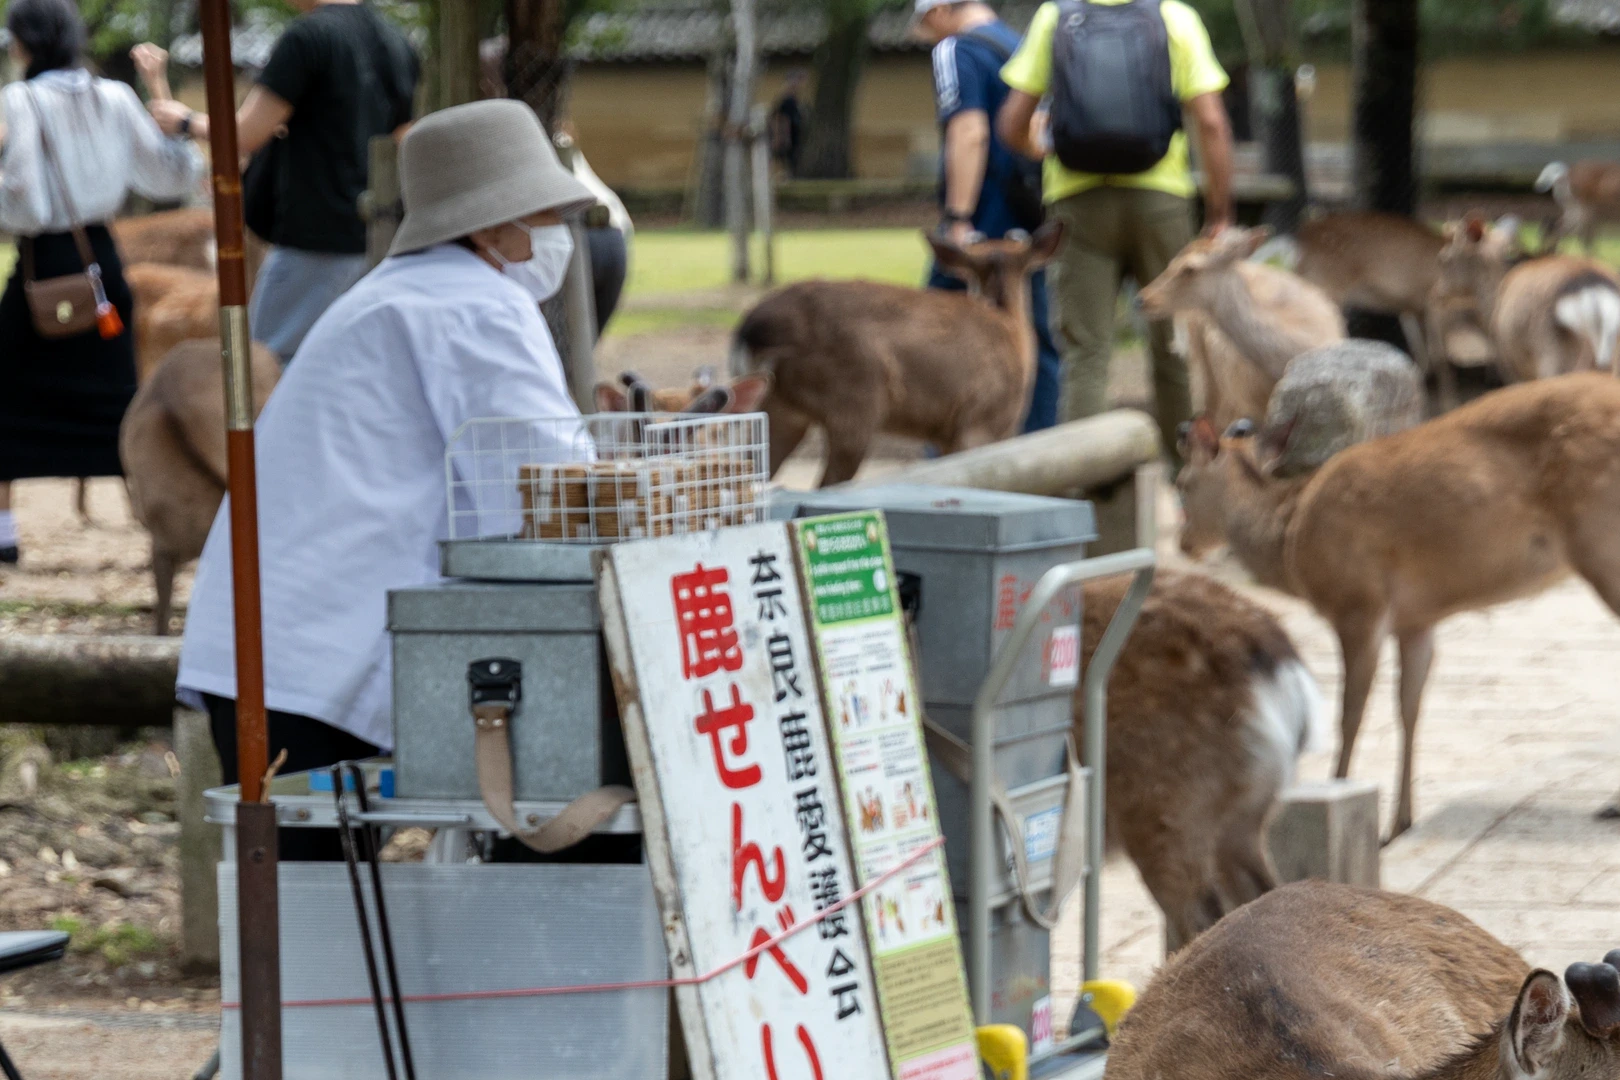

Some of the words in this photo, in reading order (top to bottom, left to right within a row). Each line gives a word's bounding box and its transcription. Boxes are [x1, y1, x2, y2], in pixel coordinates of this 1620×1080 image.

[749, 550, 862, 1020] 奈良鹿愛護会
